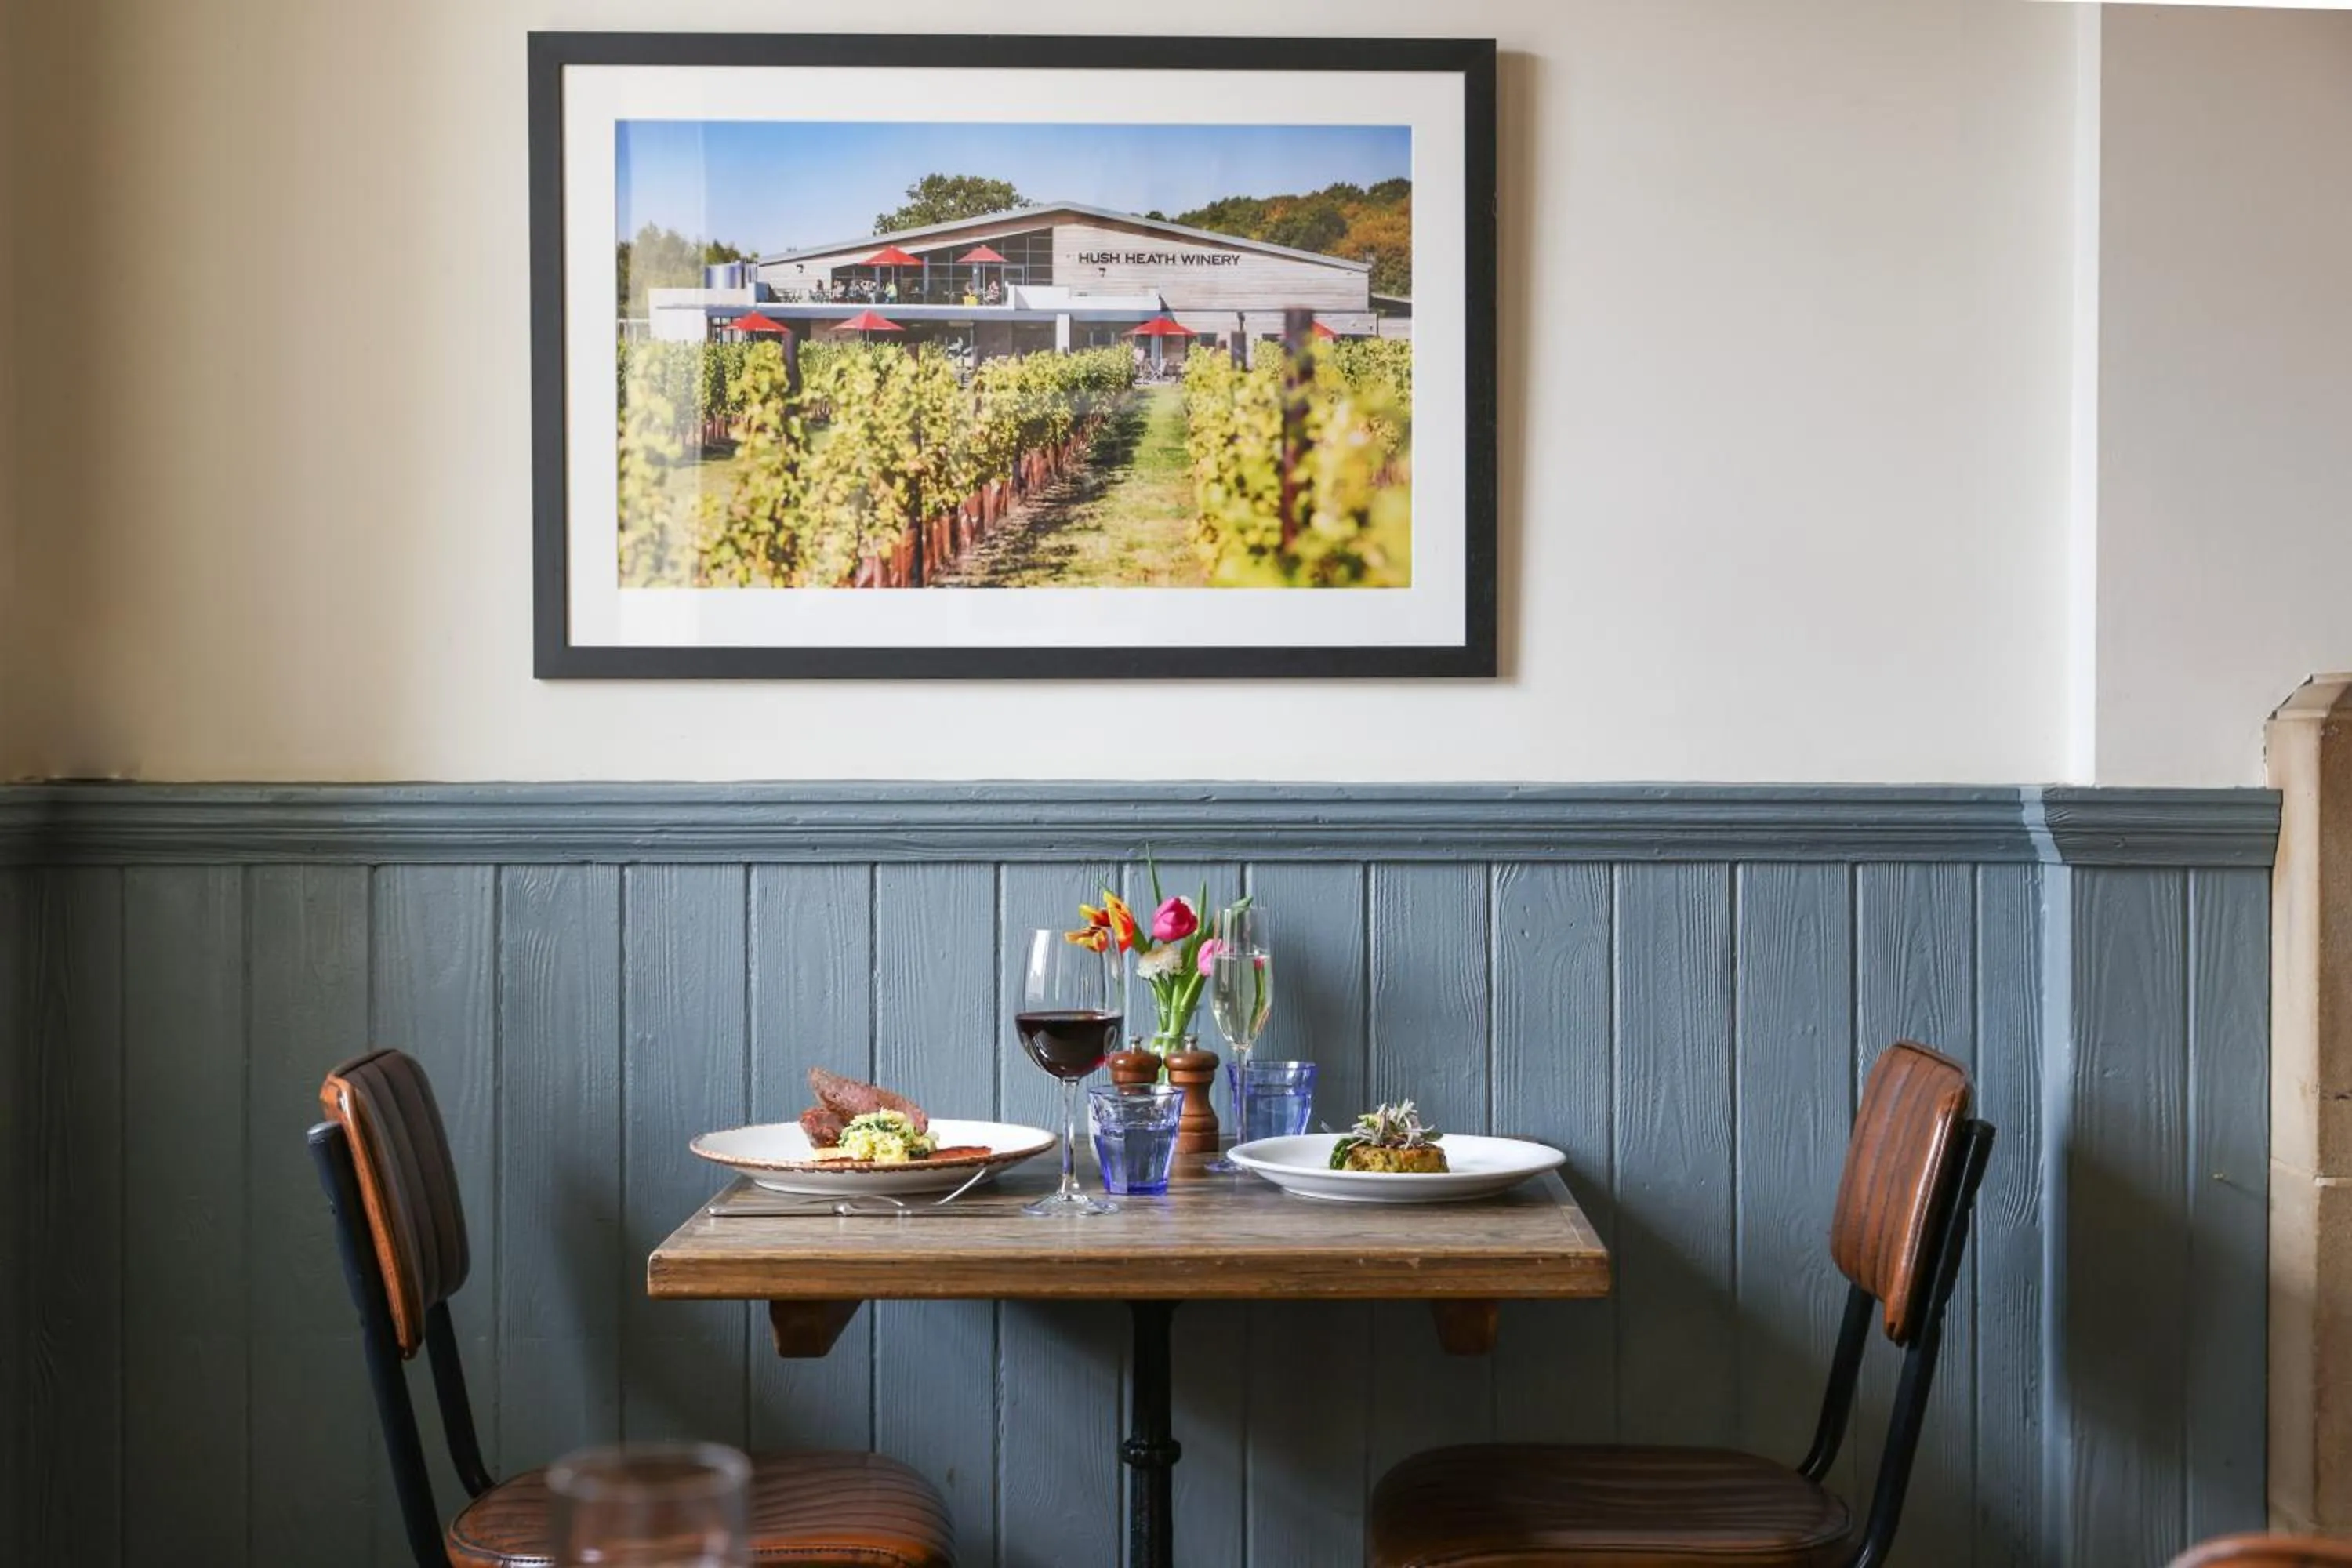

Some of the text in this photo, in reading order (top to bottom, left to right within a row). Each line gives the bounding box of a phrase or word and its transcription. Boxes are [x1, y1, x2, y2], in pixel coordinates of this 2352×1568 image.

[1079, 252, 1241, 266] HUSH HEATH WINERY
